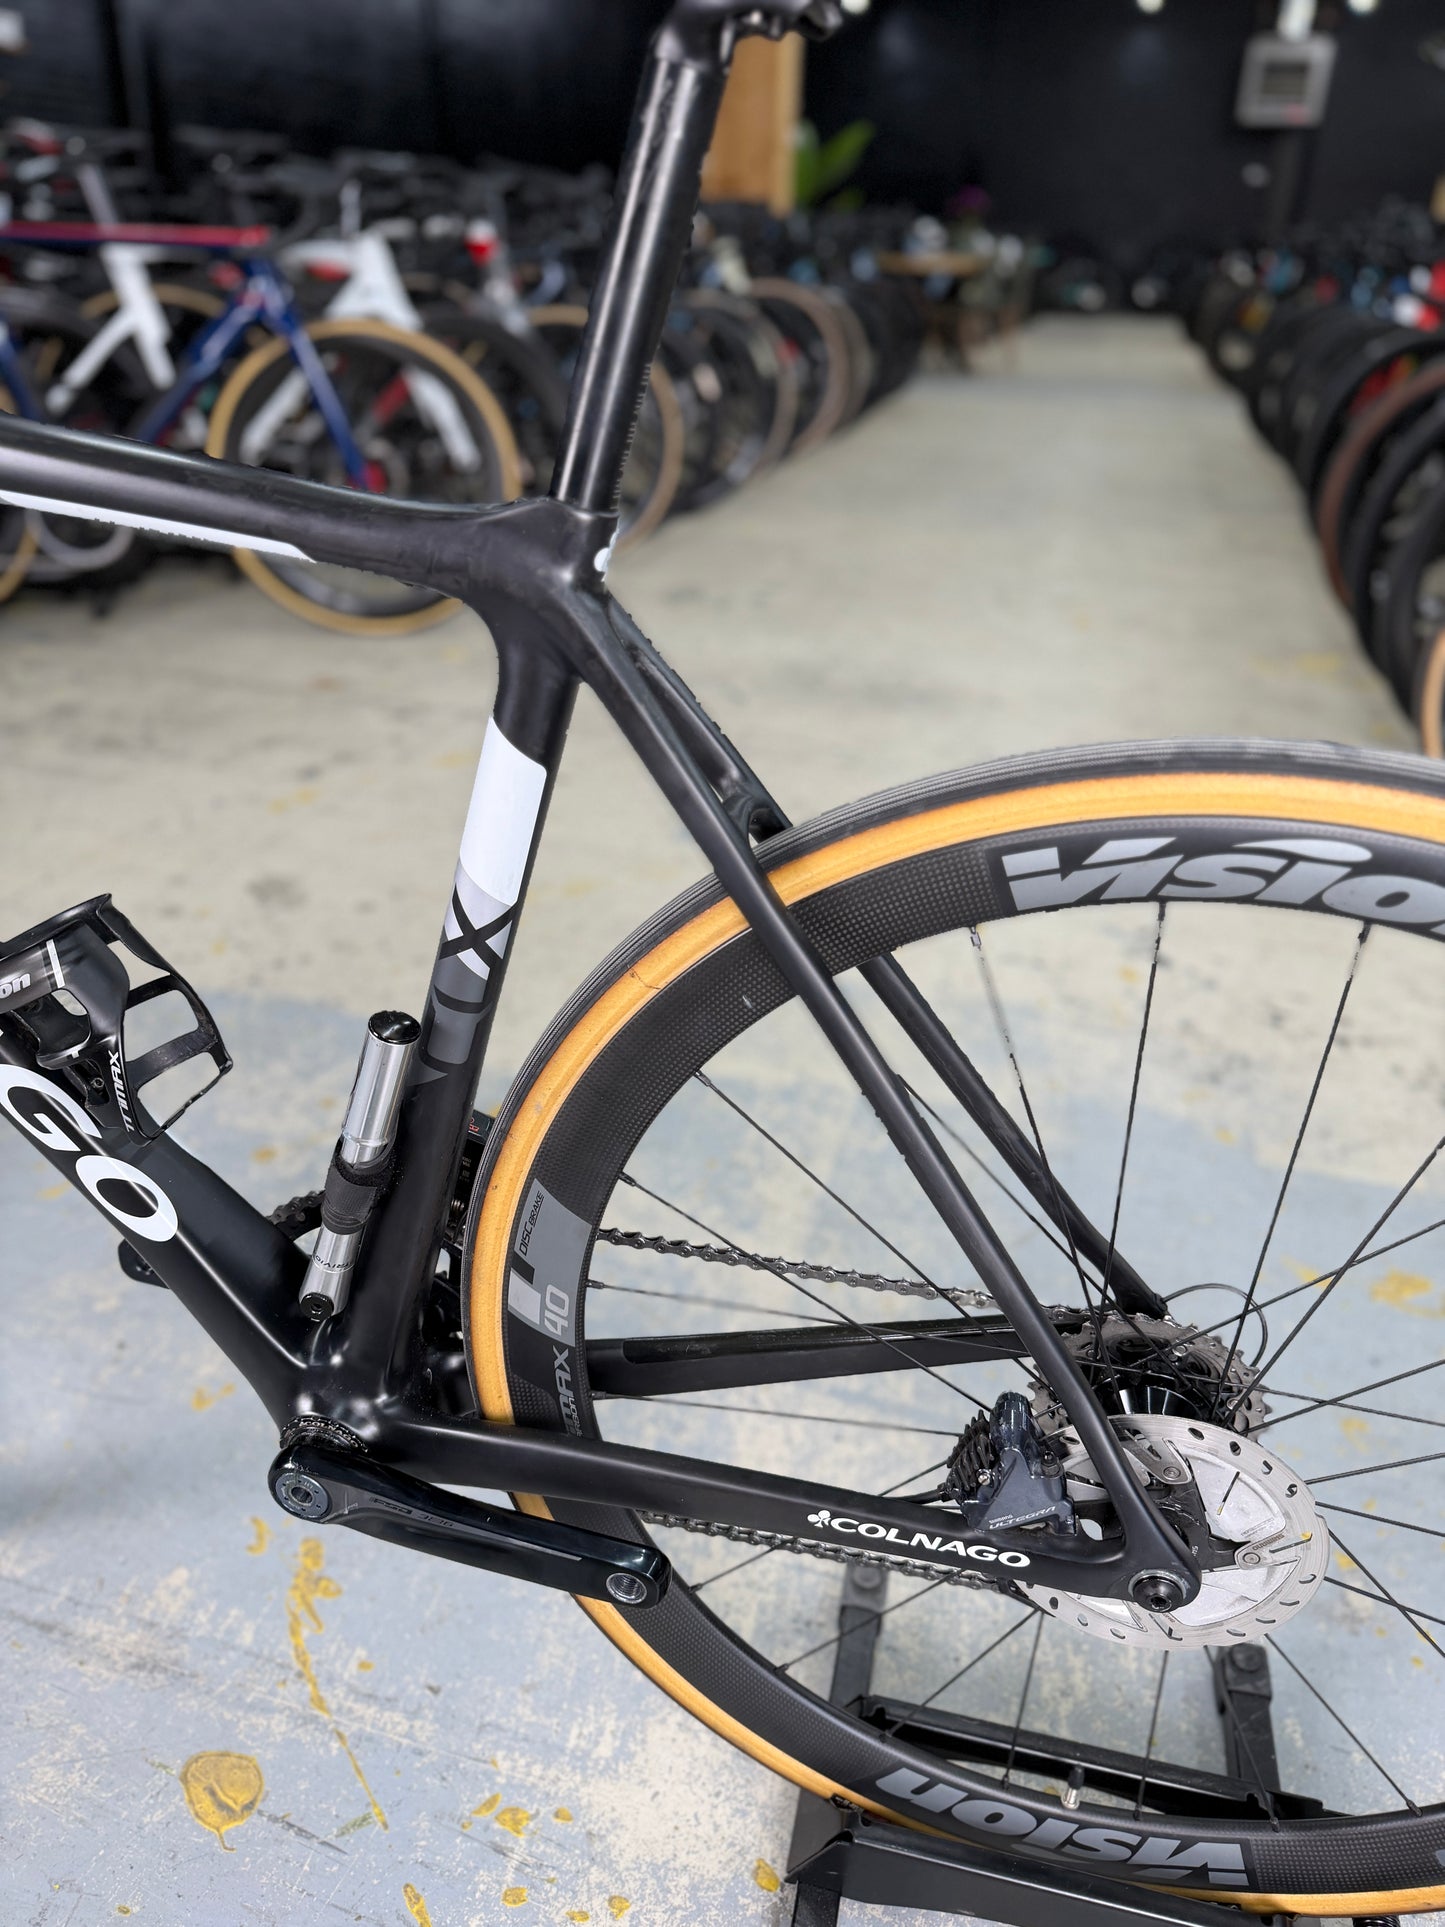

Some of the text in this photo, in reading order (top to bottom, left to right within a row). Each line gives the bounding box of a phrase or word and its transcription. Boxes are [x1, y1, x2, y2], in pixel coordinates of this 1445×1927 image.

[0, 1063, 179, 1242] GO
[519, 1190, 545, 1257] DISC BRAKE
[544, 1284, 570, 1336] 40
[829, 1517, 1031, 1569] COLNAGO
[989, 1506, 1056, 1530] ULTEGRA
